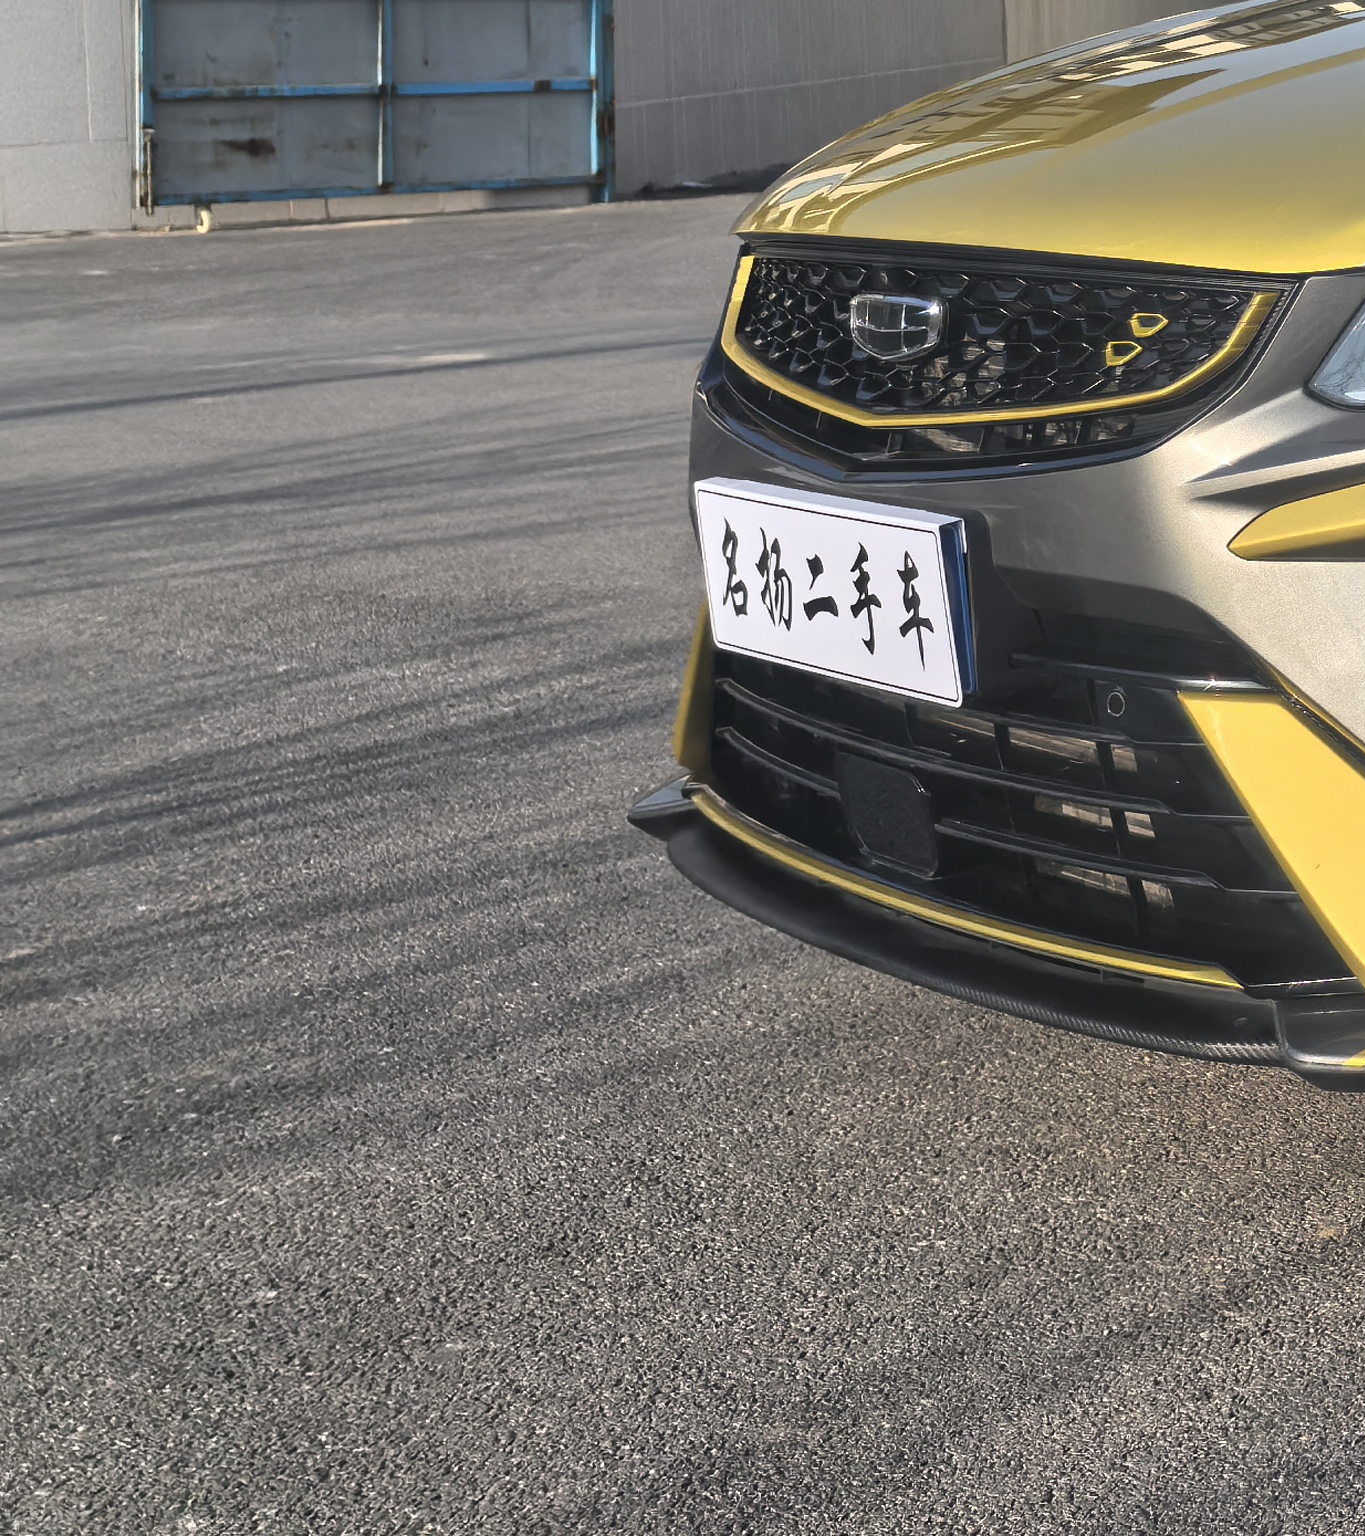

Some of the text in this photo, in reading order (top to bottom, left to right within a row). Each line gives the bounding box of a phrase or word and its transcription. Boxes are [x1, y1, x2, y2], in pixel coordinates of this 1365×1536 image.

[722, 516, 935, 672] 名扬二手车
